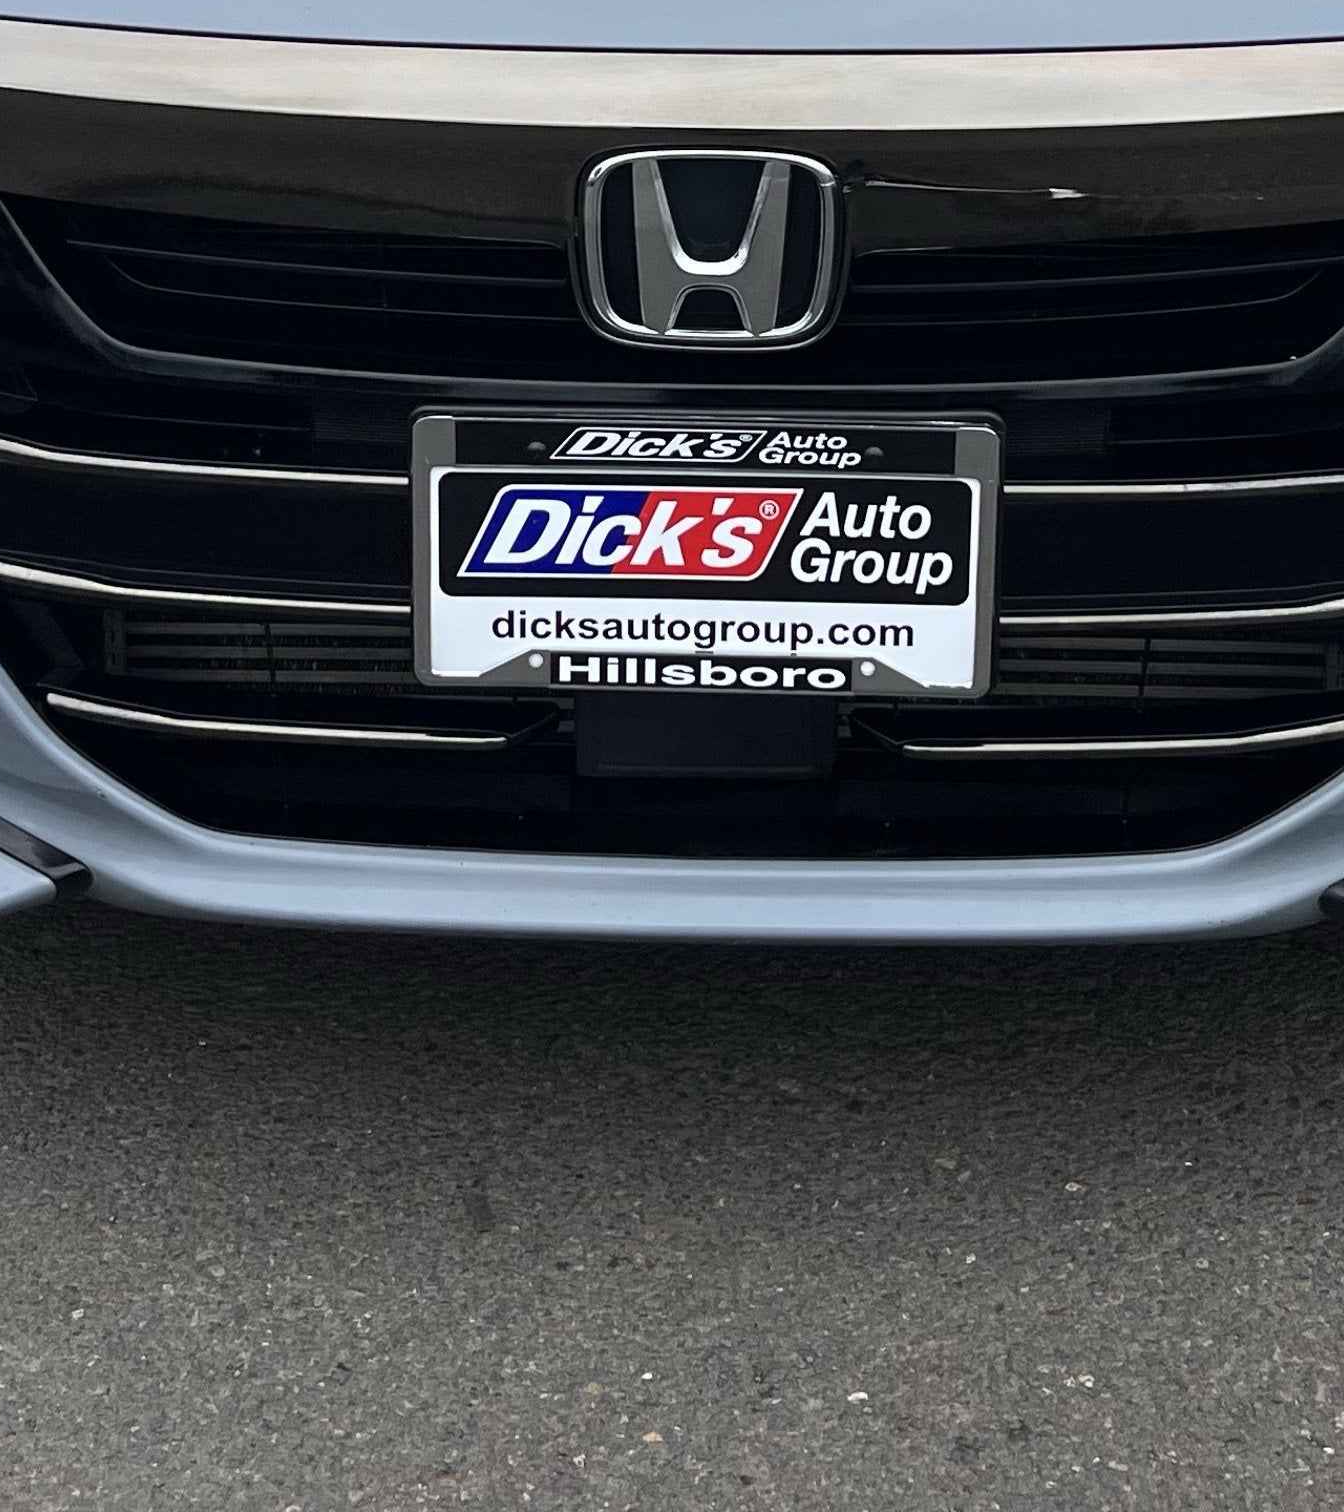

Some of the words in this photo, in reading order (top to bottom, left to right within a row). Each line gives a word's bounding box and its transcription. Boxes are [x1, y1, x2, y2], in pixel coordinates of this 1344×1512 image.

[565, 430, 742, 459] Dick's
[758, 446, 862, 469] Group
[765, 431, 848, 450] Auto
[483, 495, 764, 569] Dick's
[798, 491, 932, 540] Auto
[789, 537, 954, 595] Group
[491, 609, 915, 648] dicksautogroup.com
[557, 655, 847, 690] Hillsboro
